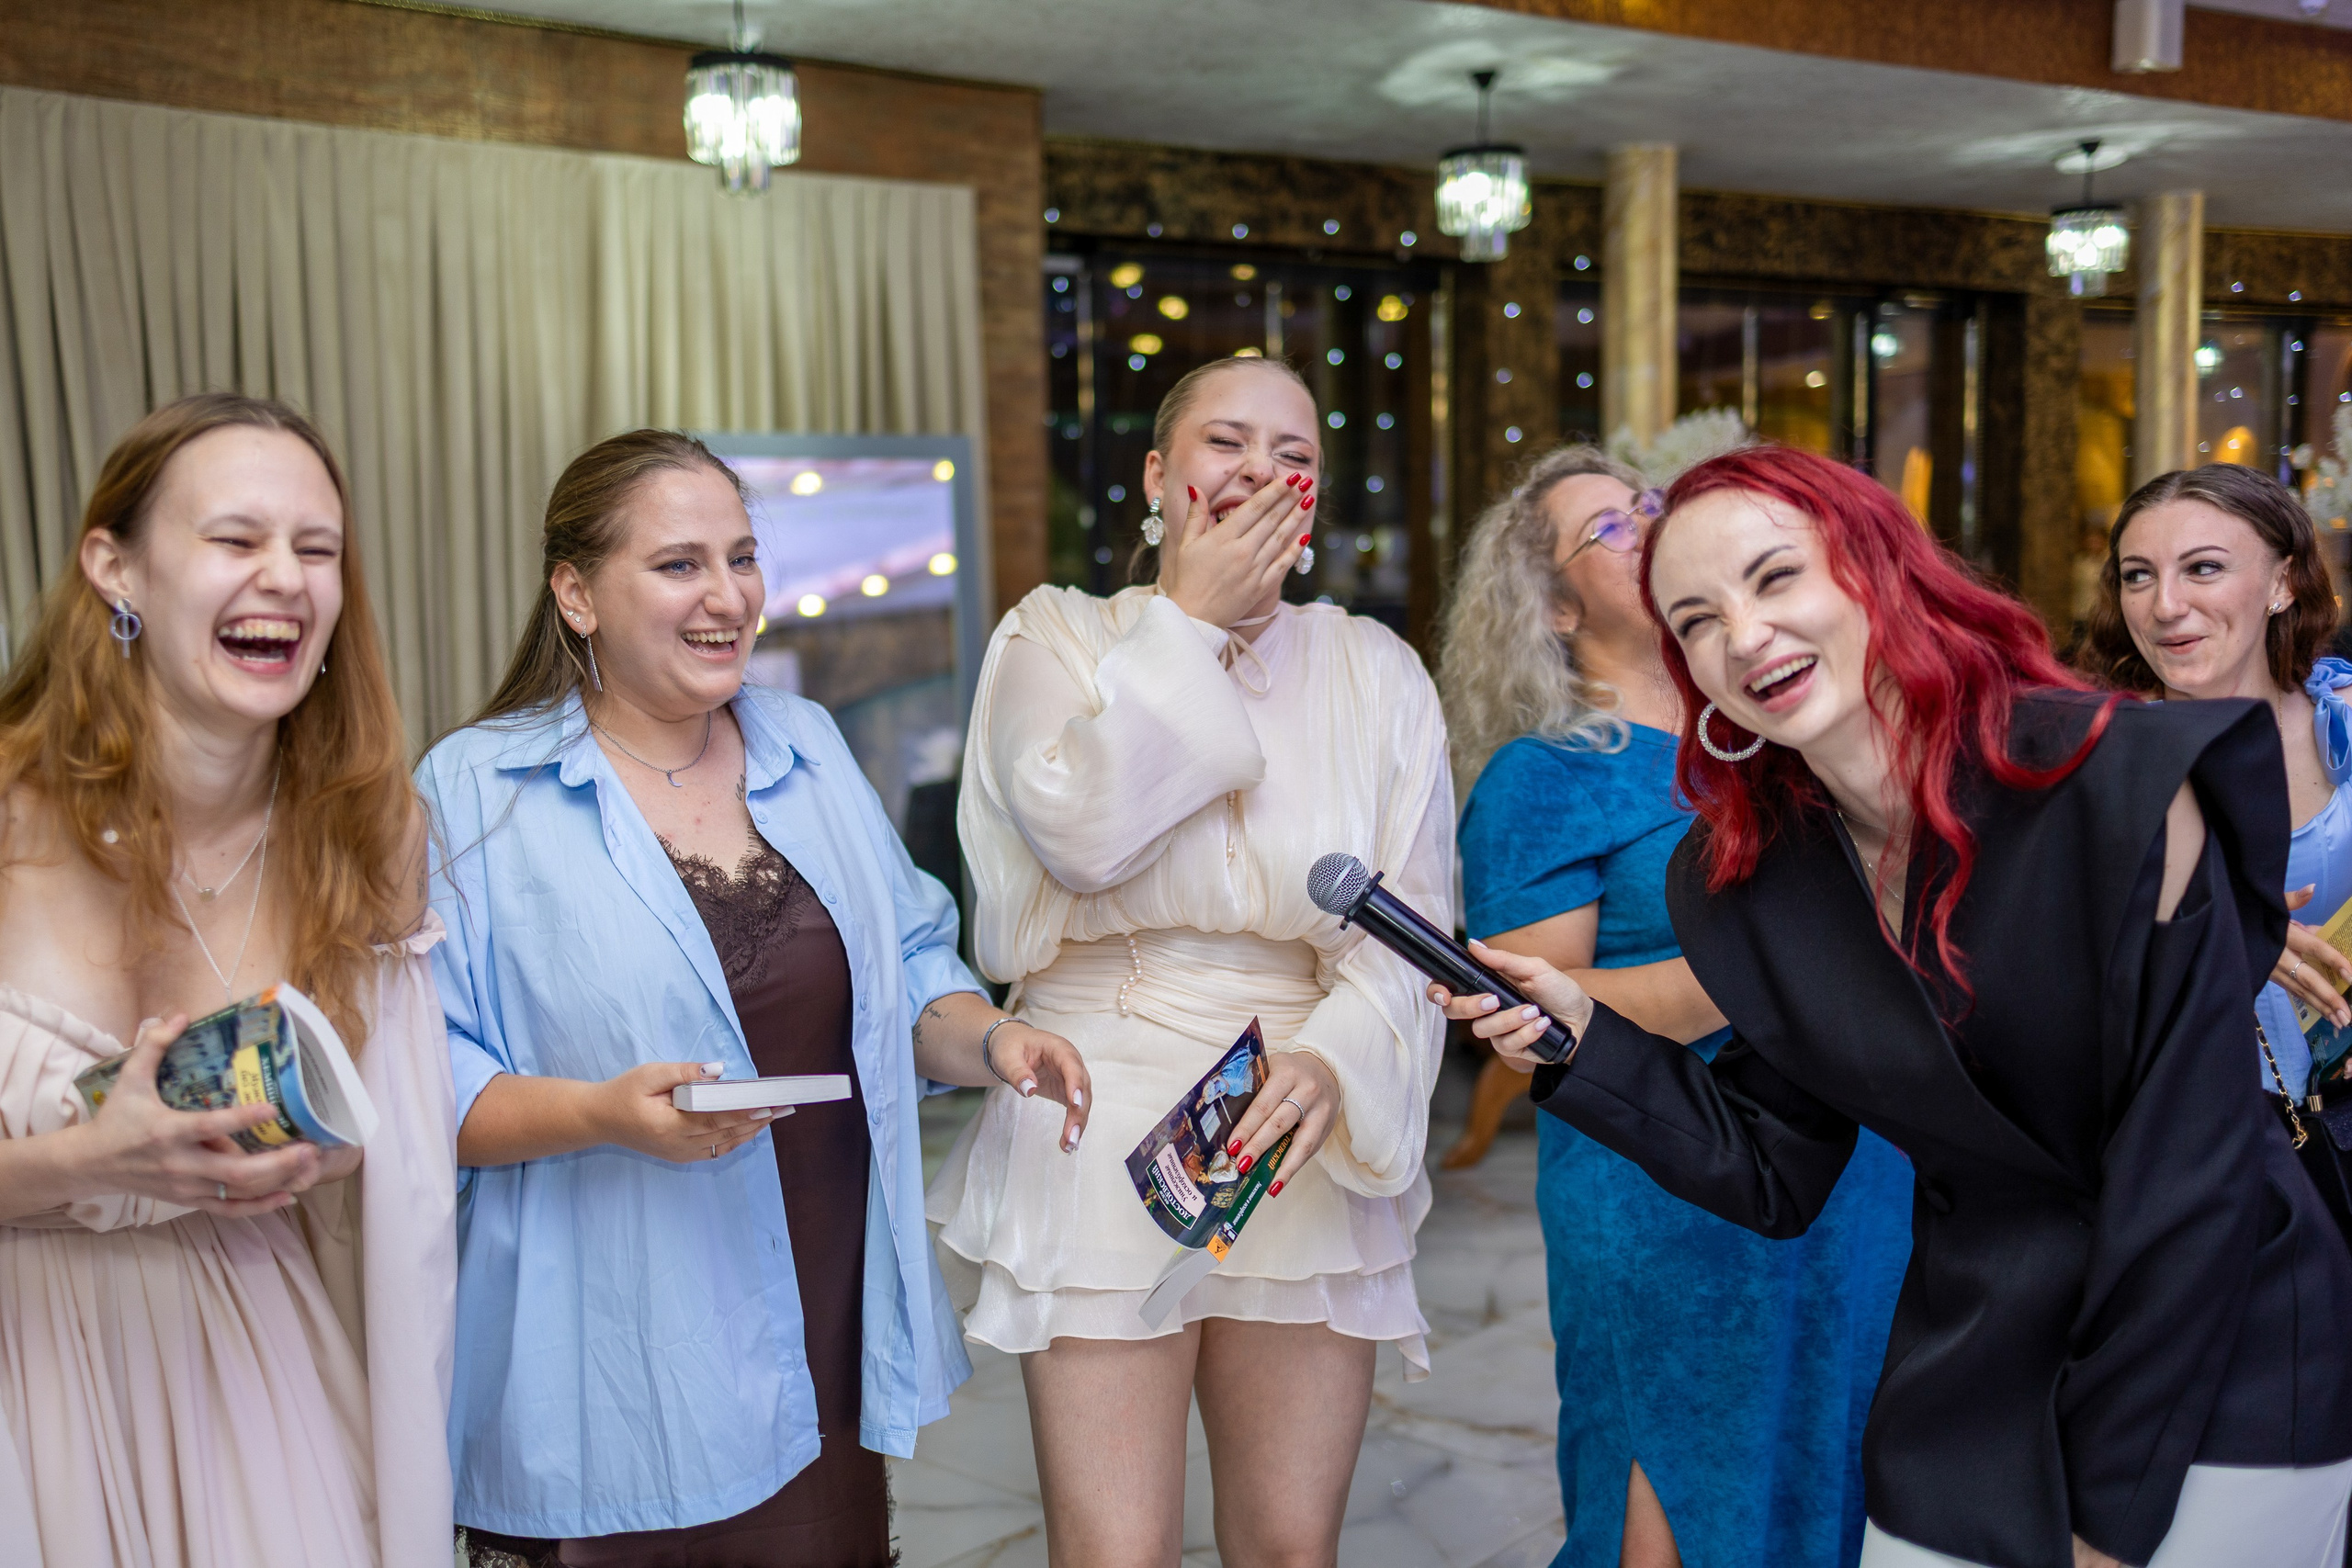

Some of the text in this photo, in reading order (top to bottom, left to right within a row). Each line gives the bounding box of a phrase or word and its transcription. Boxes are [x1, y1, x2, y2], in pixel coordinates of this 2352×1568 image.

[1268, 1126, 1296, 1170] ОСТОЕВСКИЙ
[1152, 1164, 1192, 1221] ДОСТОЕВСКИЙ
[1164, 1165, 1189, 1202] Униженные
[1167, 1153, 1193, 1196] оскорбленные
